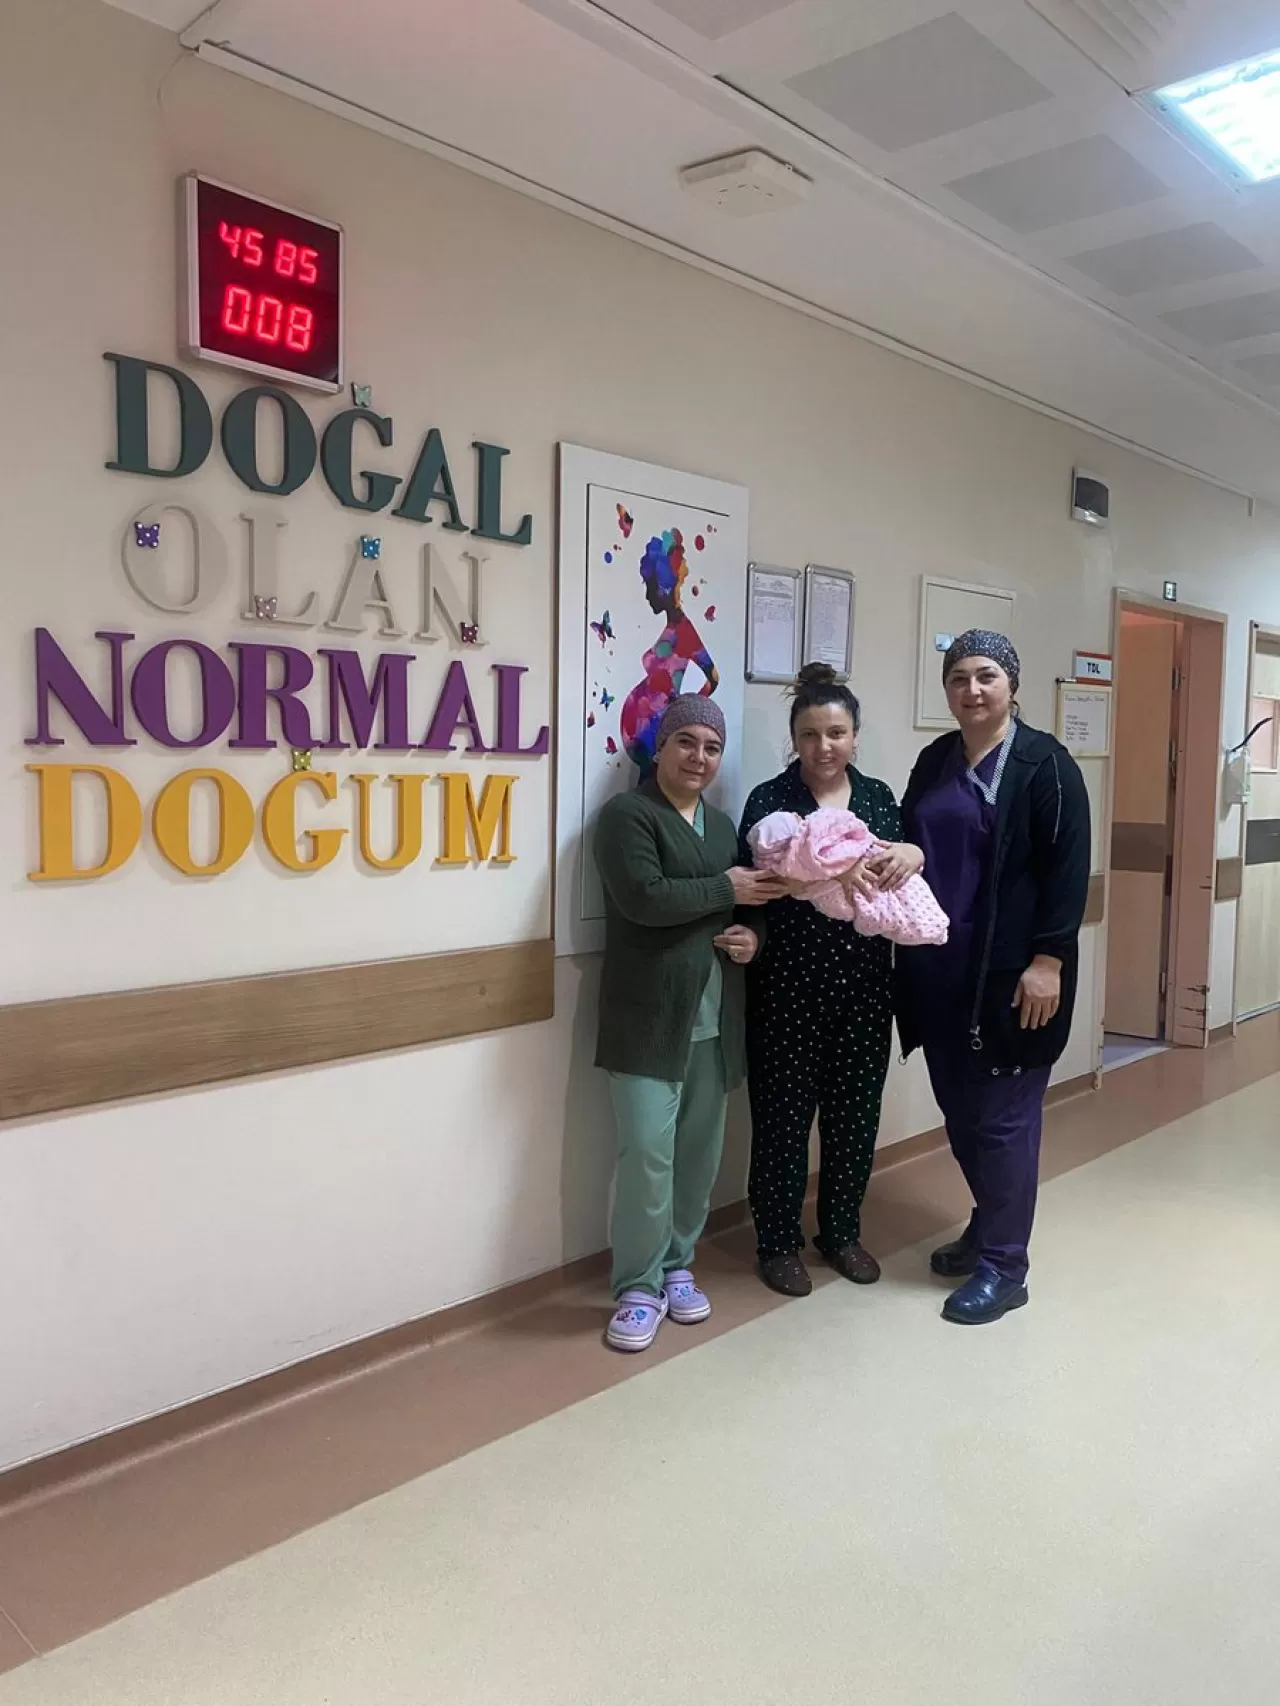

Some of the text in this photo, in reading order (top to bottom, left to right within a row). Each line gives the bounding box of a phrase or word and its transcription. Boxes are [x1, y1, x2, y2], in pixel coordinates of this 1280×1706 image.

[219, 220, 319, 284] 45 85
[223, 285, 313, 351] 008
[103, 352, 533, 544] DOĞAL
[121, 501, 491, 645] OLAN
[24, 627, 549, 754] NORMAL
[1087, 662, 1101, 674] TDL
[24, 751, 520, 881] DOĞUM
